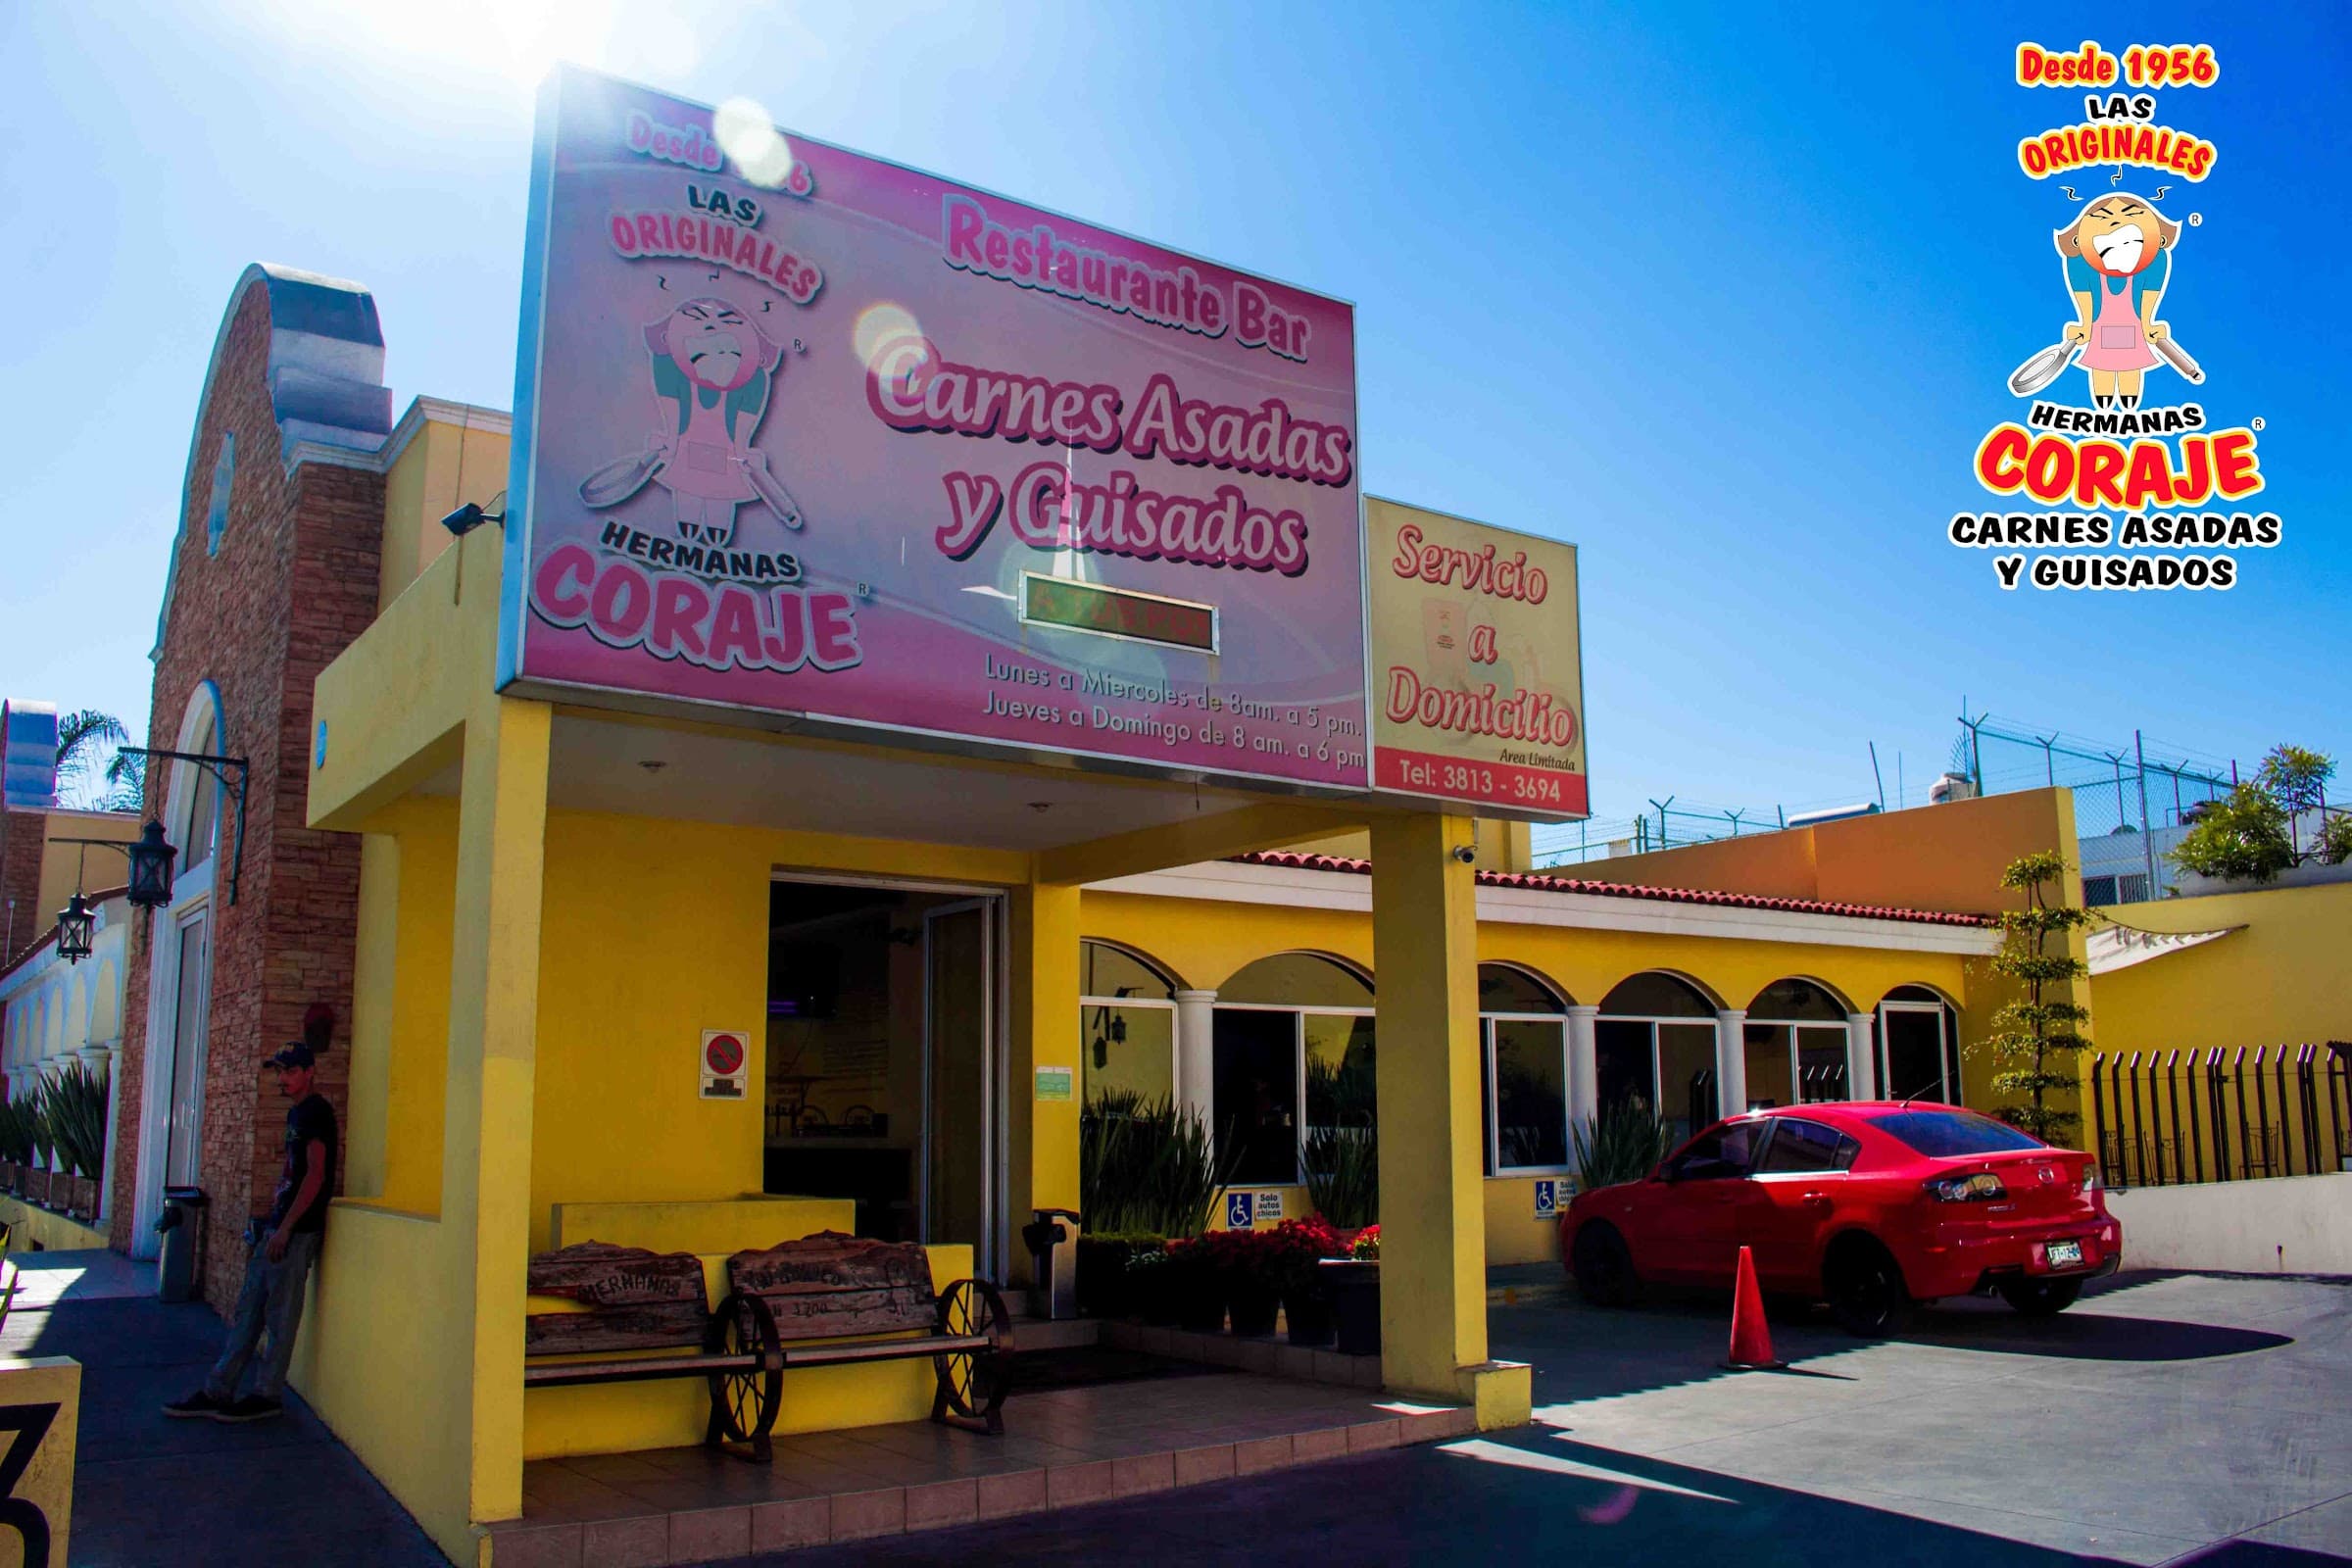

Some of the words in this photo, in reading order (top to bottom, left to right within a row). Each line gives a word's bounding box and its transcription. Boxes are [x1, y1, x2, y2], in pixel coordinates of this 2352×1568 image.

[630, 114, 718, 167] Desde
[688, 183, 759, 221] LAS
[612, 214, 818, 299] ORIGINALES
[949, 199, 1221, 328] Restaurante
[1239, 288, 1307, 357] Bar
[874, 340, 1119, 447] Carnes
[1129, 379, 1348, 480] Asadas
[600, 520, 800, 579] HERMANAS
[940, 475, 997, 553] y
[1012, 466, 1304, 568] Guisados
[1393, 524, 1547, 605] Servicio
[535, 544, 858, 665] CORAJE
[1468, 624, 1498, 663] a
[983, 689, 1062, 725] Jueves
[1069, 708, 1085, 727] a
[1092, 705, 1192, 746] Domingo
[1198, 718, 1226, 747] de
[1232, 726, 1247, 749] 8
[1251, 734, 1290, 756] am.
[1297, 743, 1310, 760] a
[1316, 737, 1329, 762] 6
[986, 652, 1051, 688] Lunes
[1058, 672, 1074, 691] a
[1081, 669, 1190, 709] Miercoles
[1195, 685, 1223, 712] de
[1230, 692, 1280, 722] 8am.
[1287, 707, 1300, 726] a
[1306, 706, 1319, 728] 5
[1325, 712, 1362, 739] pm.
[1387, 666, 1574, 747] Domicilio
[1398, 759, 1438, 788] Tel:
[1443, 764, 1494, 794] 3813
[1513, 774, 1561, 803] 3694
[1499, 748, 1526, 765] Area
[1528, 752, 1576, 772] Limitada
[1256, 1209, 1281, 1218] chicos
[1259, 1193, 1278, 1202] Solo
